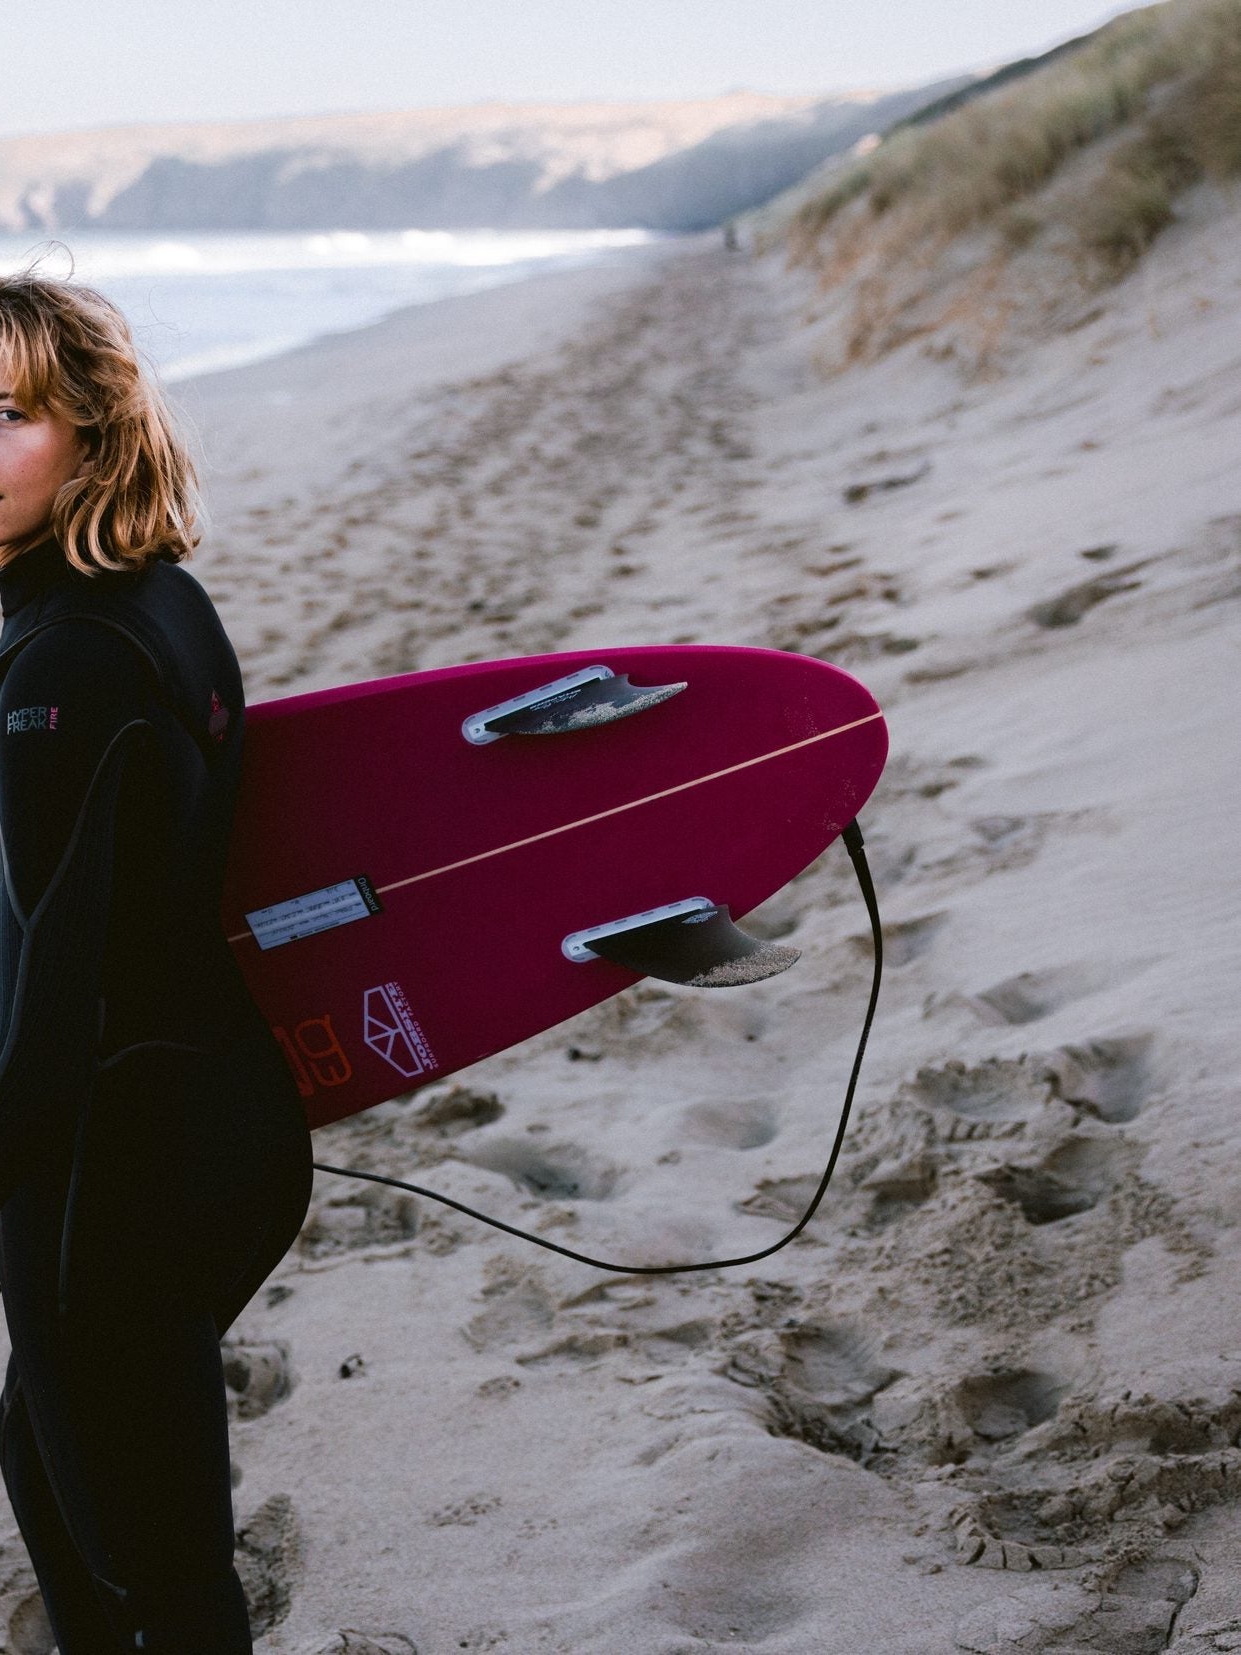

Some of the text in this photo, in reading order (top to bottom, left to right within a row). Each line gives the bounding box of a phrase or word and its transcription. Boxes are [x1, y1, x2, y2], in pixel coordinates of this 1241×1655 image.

[7, 706, 48, 724] HYPER
[7, 718, 47, 735] FREAK
[49, 706, 59, 730] FIRE
[358, 877, 379, 911] Onboard
[385, 982, 434, 1070] JOBSITE
[393, 981, 439, 1068] SURFBOARD FACTORY
